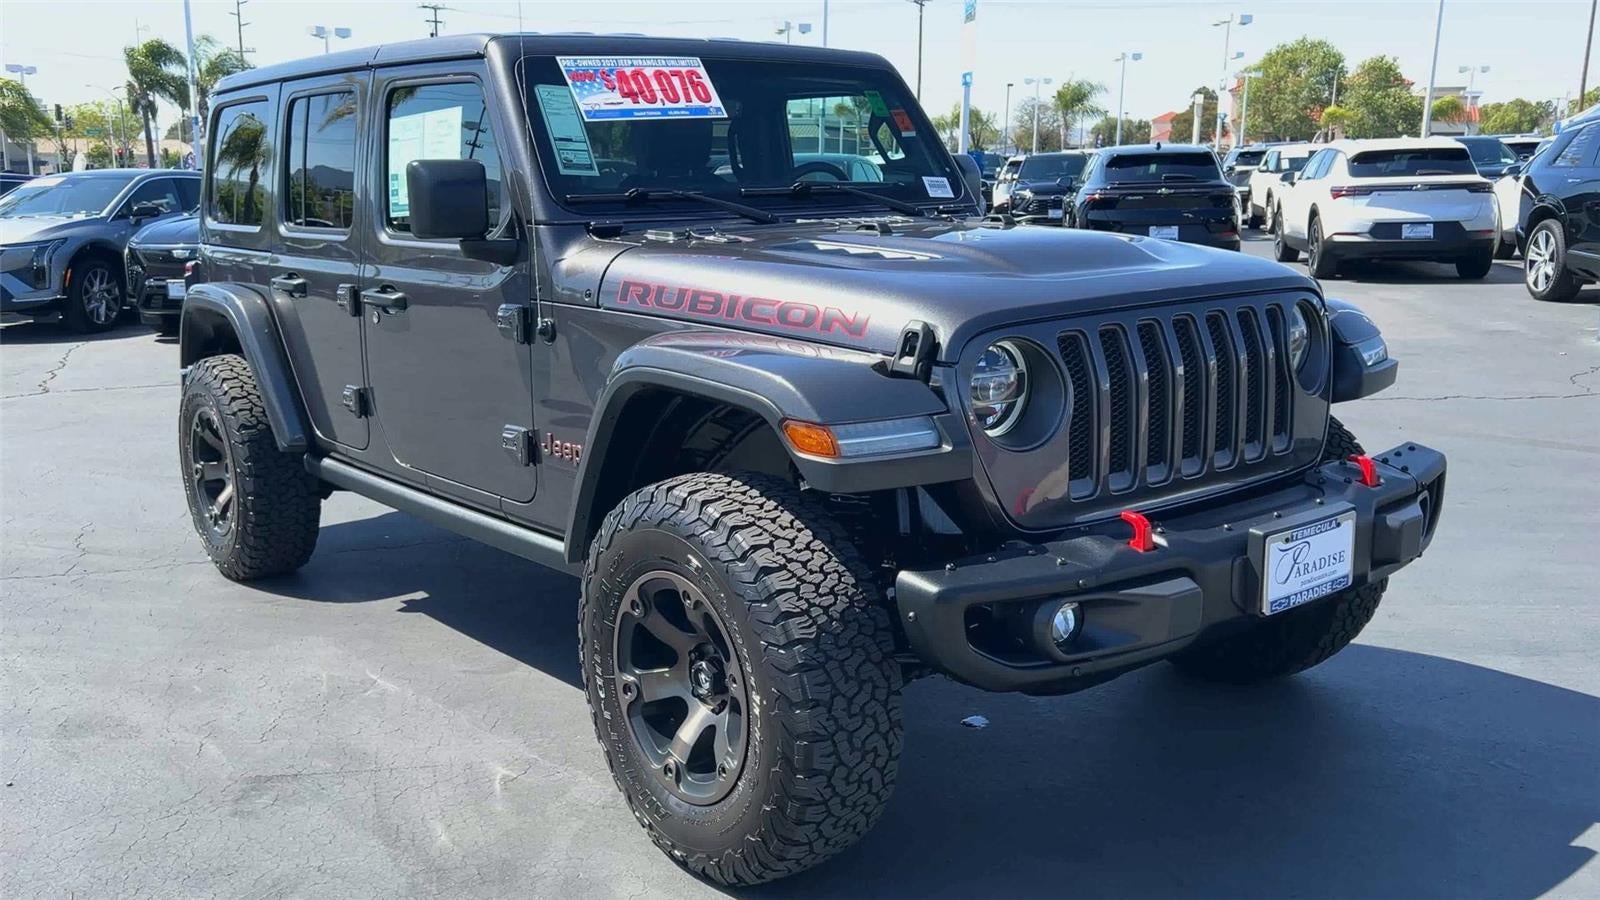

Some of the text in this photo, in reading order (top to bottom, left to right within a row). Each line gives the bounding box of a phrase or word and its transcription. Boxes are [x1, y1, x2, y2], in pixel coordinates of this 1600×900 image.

[561, 59, 700, 67] PRE-OWNED 2021 JEEP WRANGLER UNLIMITED
[600, 68, 713, 106] $40,076
[617, 280, 871, 339] RUBICON
[541, 432, 583, 466] Jeep
[1291, 520, 1337, 541] TEMECULA
[1289, 583, 1332, 606] PARADISE
